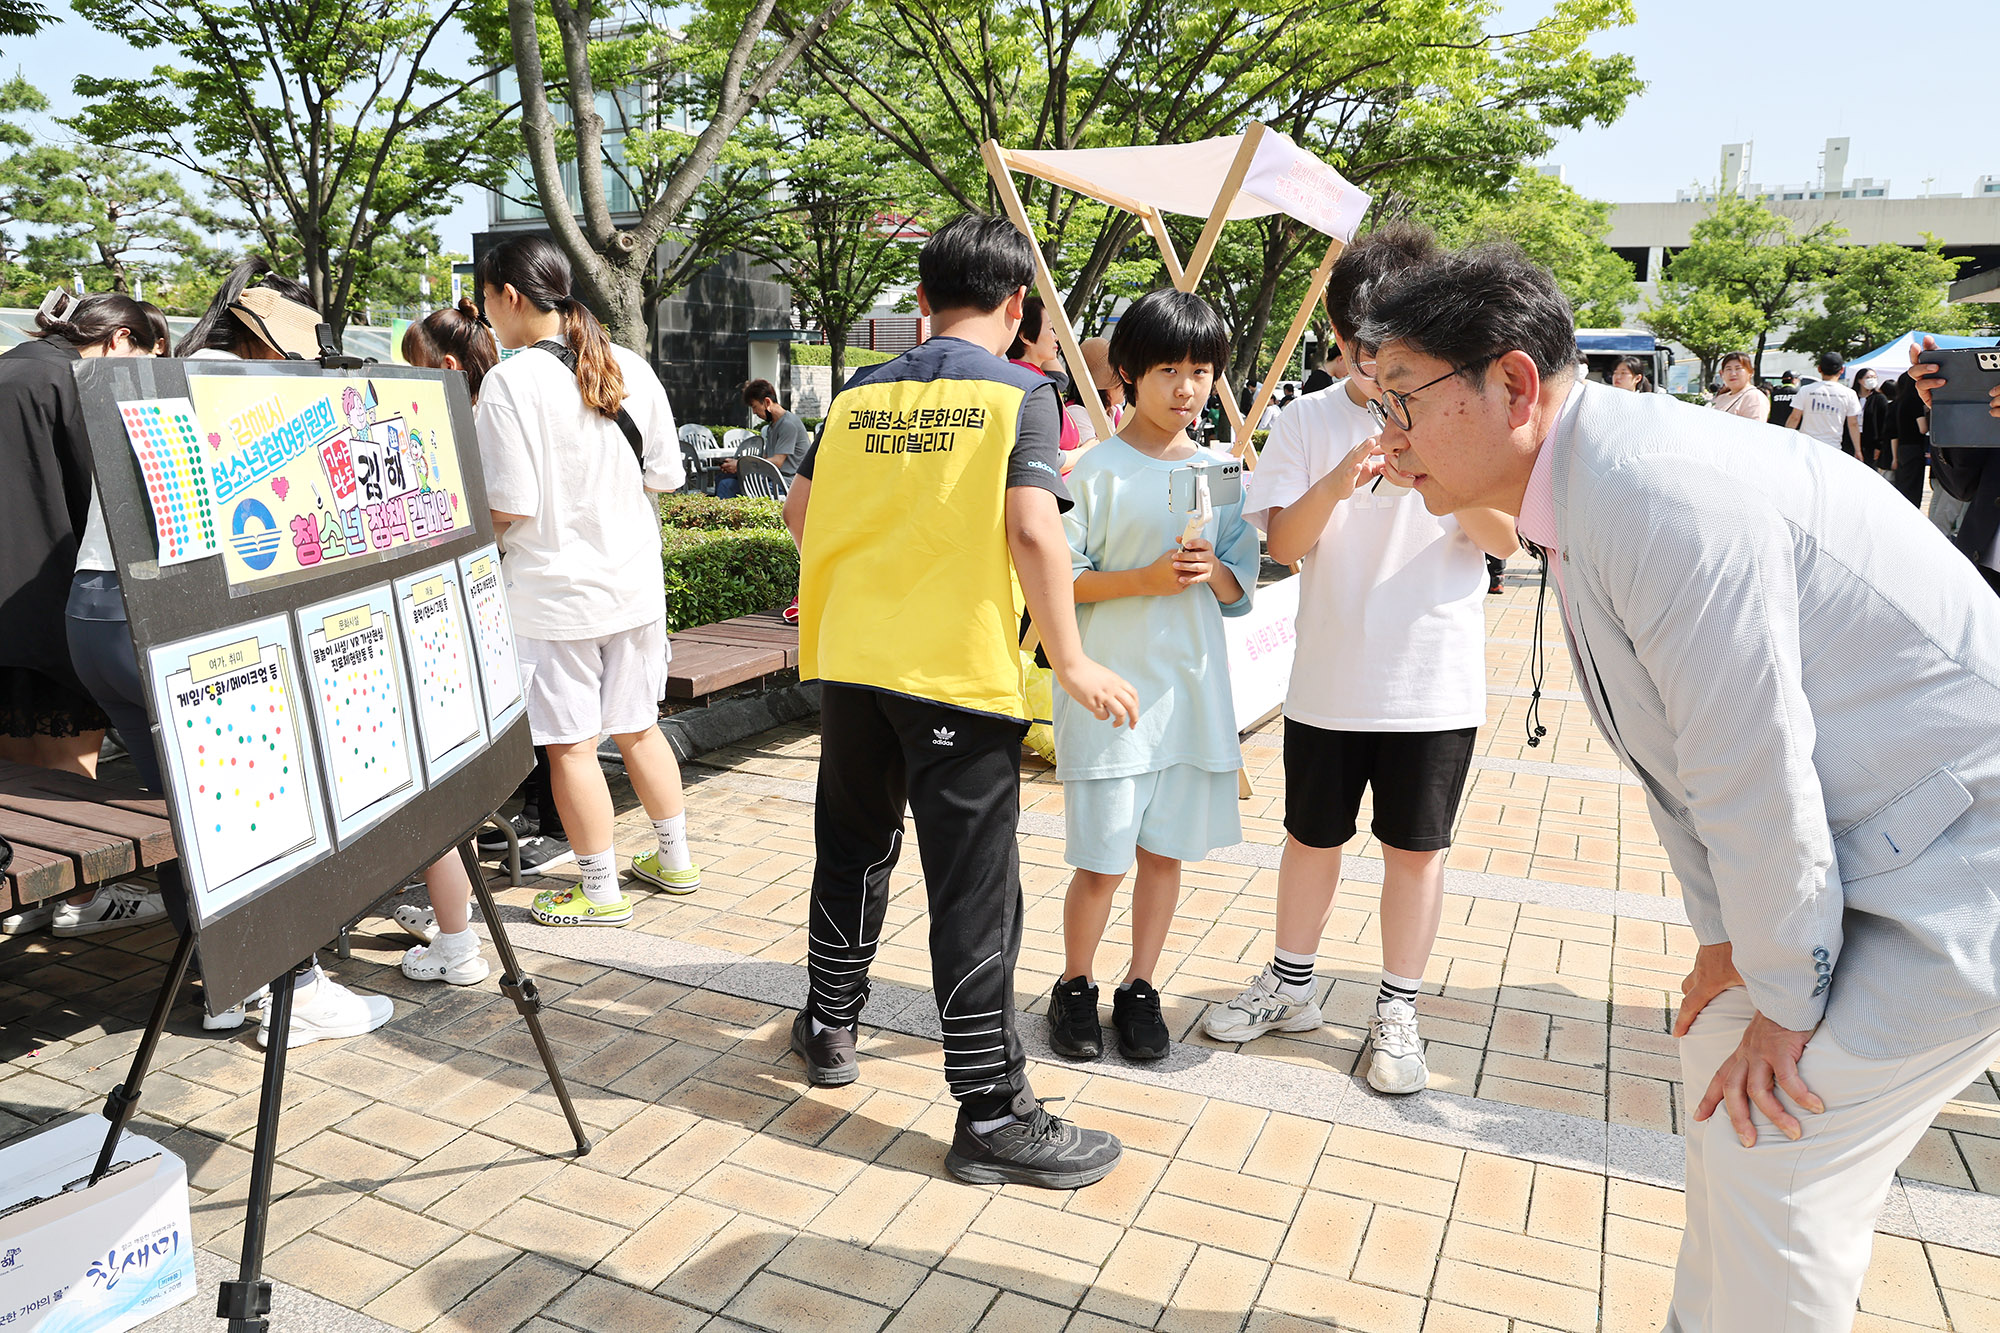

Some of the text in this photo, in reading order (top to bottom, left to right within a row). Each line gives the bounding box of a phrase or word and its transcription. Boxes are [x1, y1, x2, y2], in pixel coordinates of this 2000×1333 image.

[230, 395, 286, 447] 김해시
[211, 396, 336, 499] 청소년참여위원회
[325, 443, 350, 468] 가야
[333, 466, 356, 495] 왕도
[357, 446, 406, 501] 김해
[290, 489, 455, 566] 청소년 정책 캠페인
[338, 615, 360, 631] 문화시설
[1275, 615, 1297, 645] 달고
[228, 650, 244, 665] 취미
[313, 645, 333, 664] 물놀이
[349, 636, 360, 648] VR
[360, 627, 384, 645] 가상현실
[331, 645, 374, 673] 진로체험활동 등
[177, 663, 278, 708] 게임/영화/메이크업 등
[539, 912, 579, 925] crocs
[86, 1230, 178, 1290] 찬새미
[20, 1295, 50, 1317] 가야의
